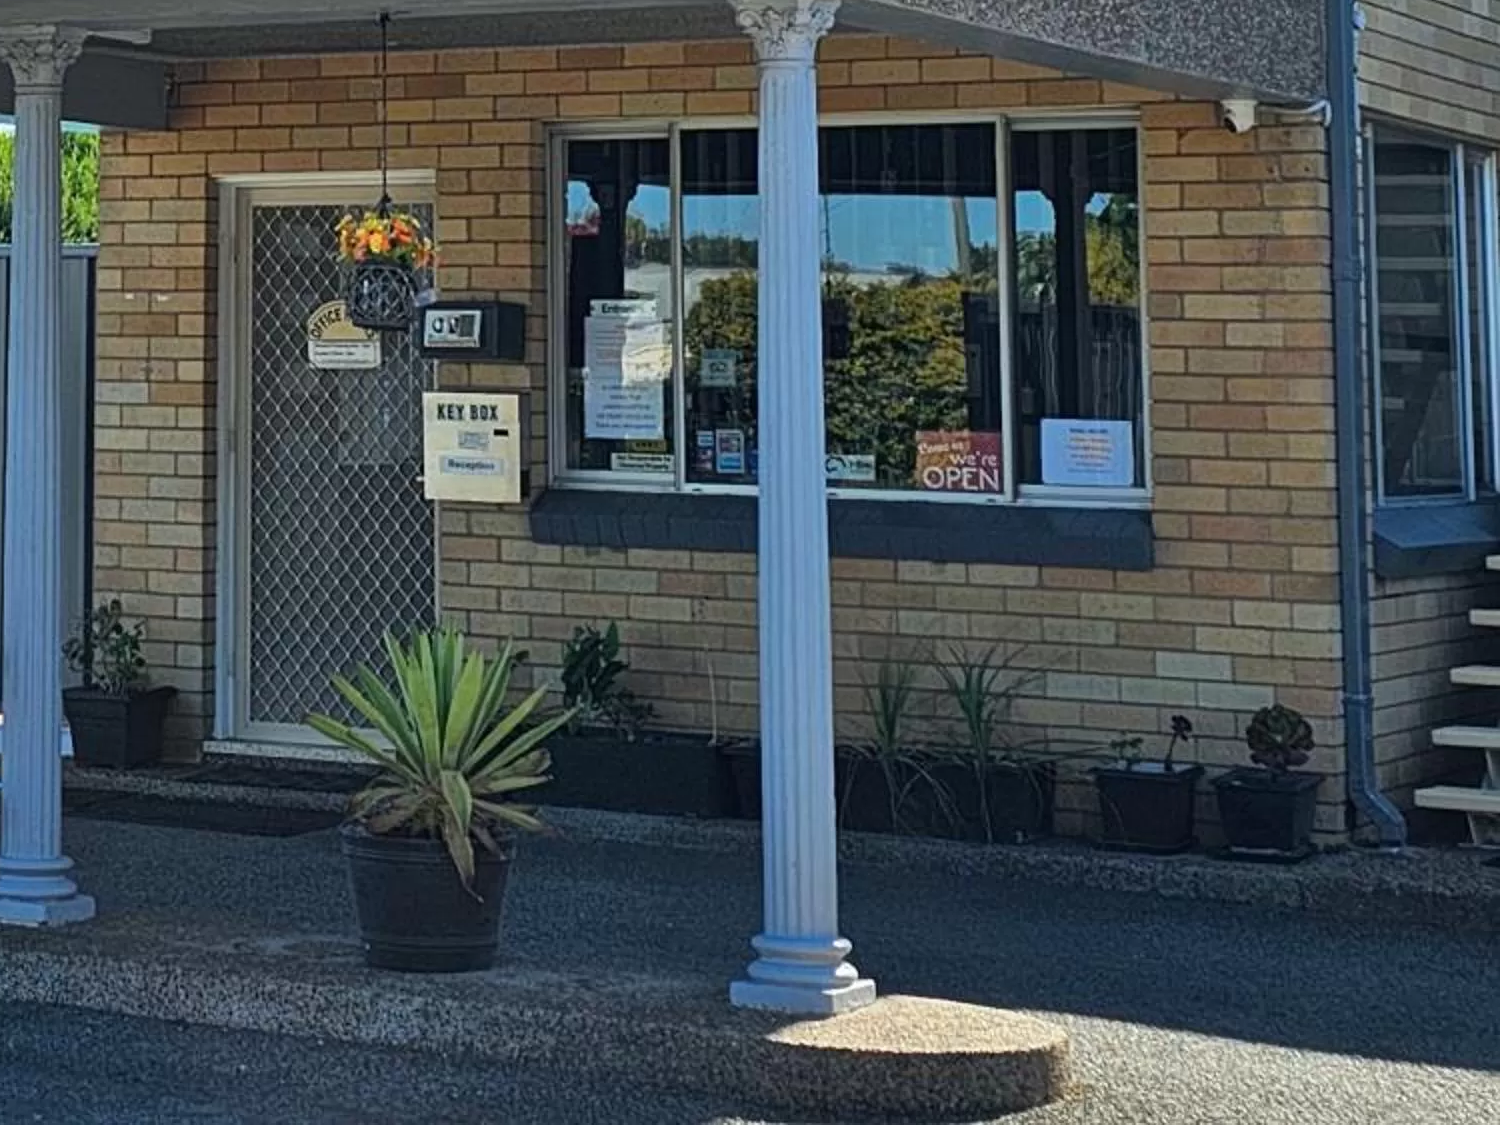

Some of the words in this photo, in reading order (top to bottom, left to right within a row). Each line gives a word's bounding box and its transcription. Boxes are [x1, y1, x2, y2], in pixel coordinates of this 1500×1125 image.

[311, 307, 342, 339] OFFICE
[437, 403, 465, 420] KEY
[469, 404, 499, 421] BOX
[447, 458, 496, 472] Reception
[949, 450, 998, 466] we're
[922, 466, 1000, 492] OPEN
